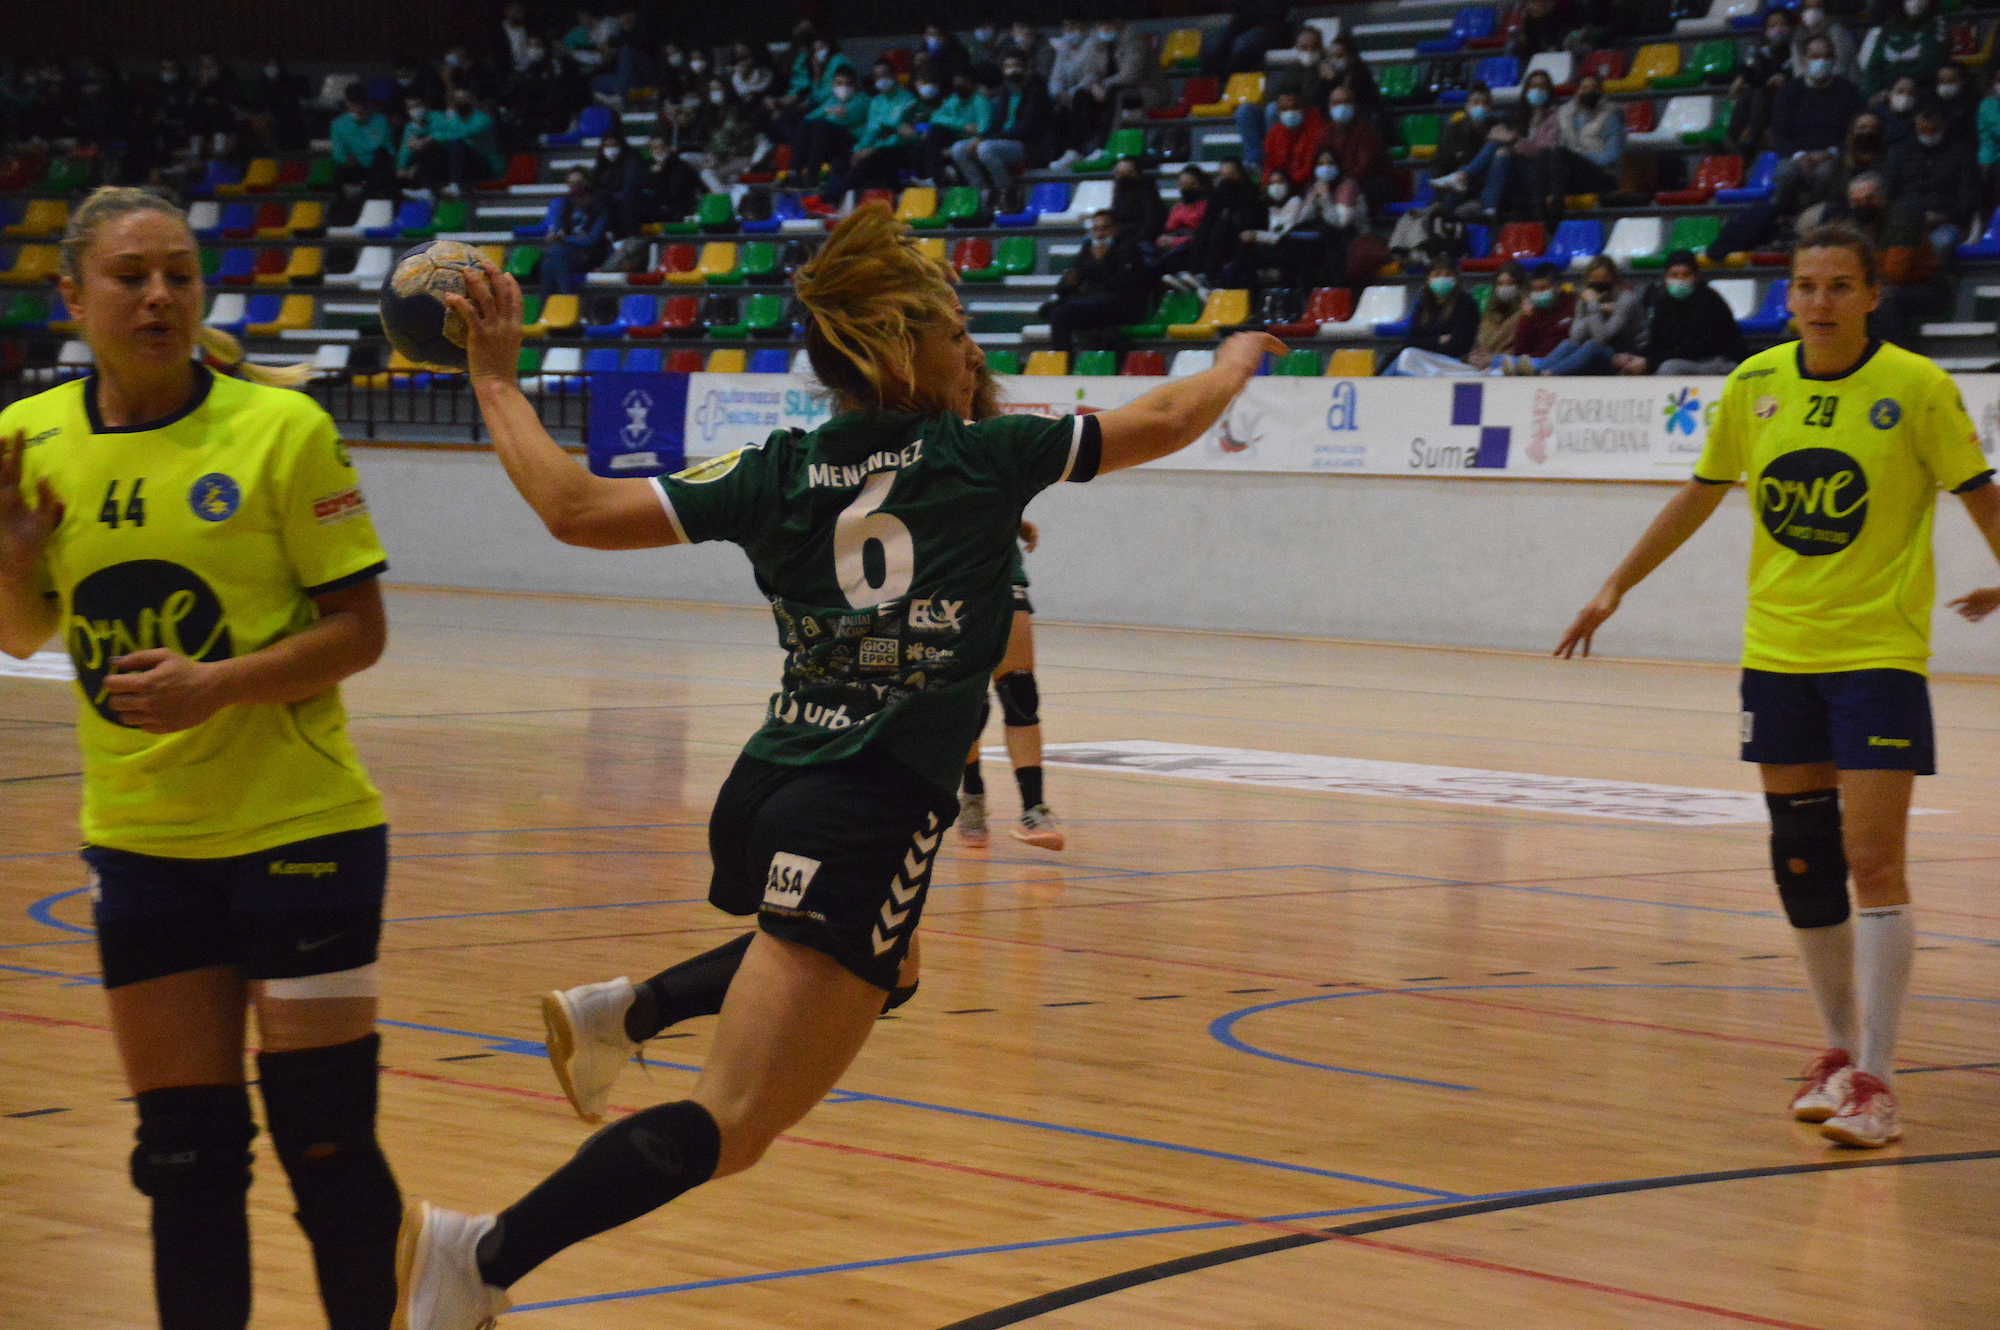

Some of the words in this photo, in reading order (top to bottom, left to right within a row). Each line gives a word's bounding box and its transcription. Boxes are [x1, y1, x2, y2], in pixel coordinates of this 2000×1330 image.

[1556, 399, 1652, 423] GENERALITAT
[1804, 395, 1839, 427] 29
[1409, 437, 1479, 469] Suma
[1556, 428, 1650, 452] VALENCIANA
[808, 438, 923, 488] MENENDEZ
[98, 477, 147, 528] 44
[833, 470, 914, 610] 6
[861, 653, 896, 665] EPPO
[862, 640, 896, 653] GIOS
